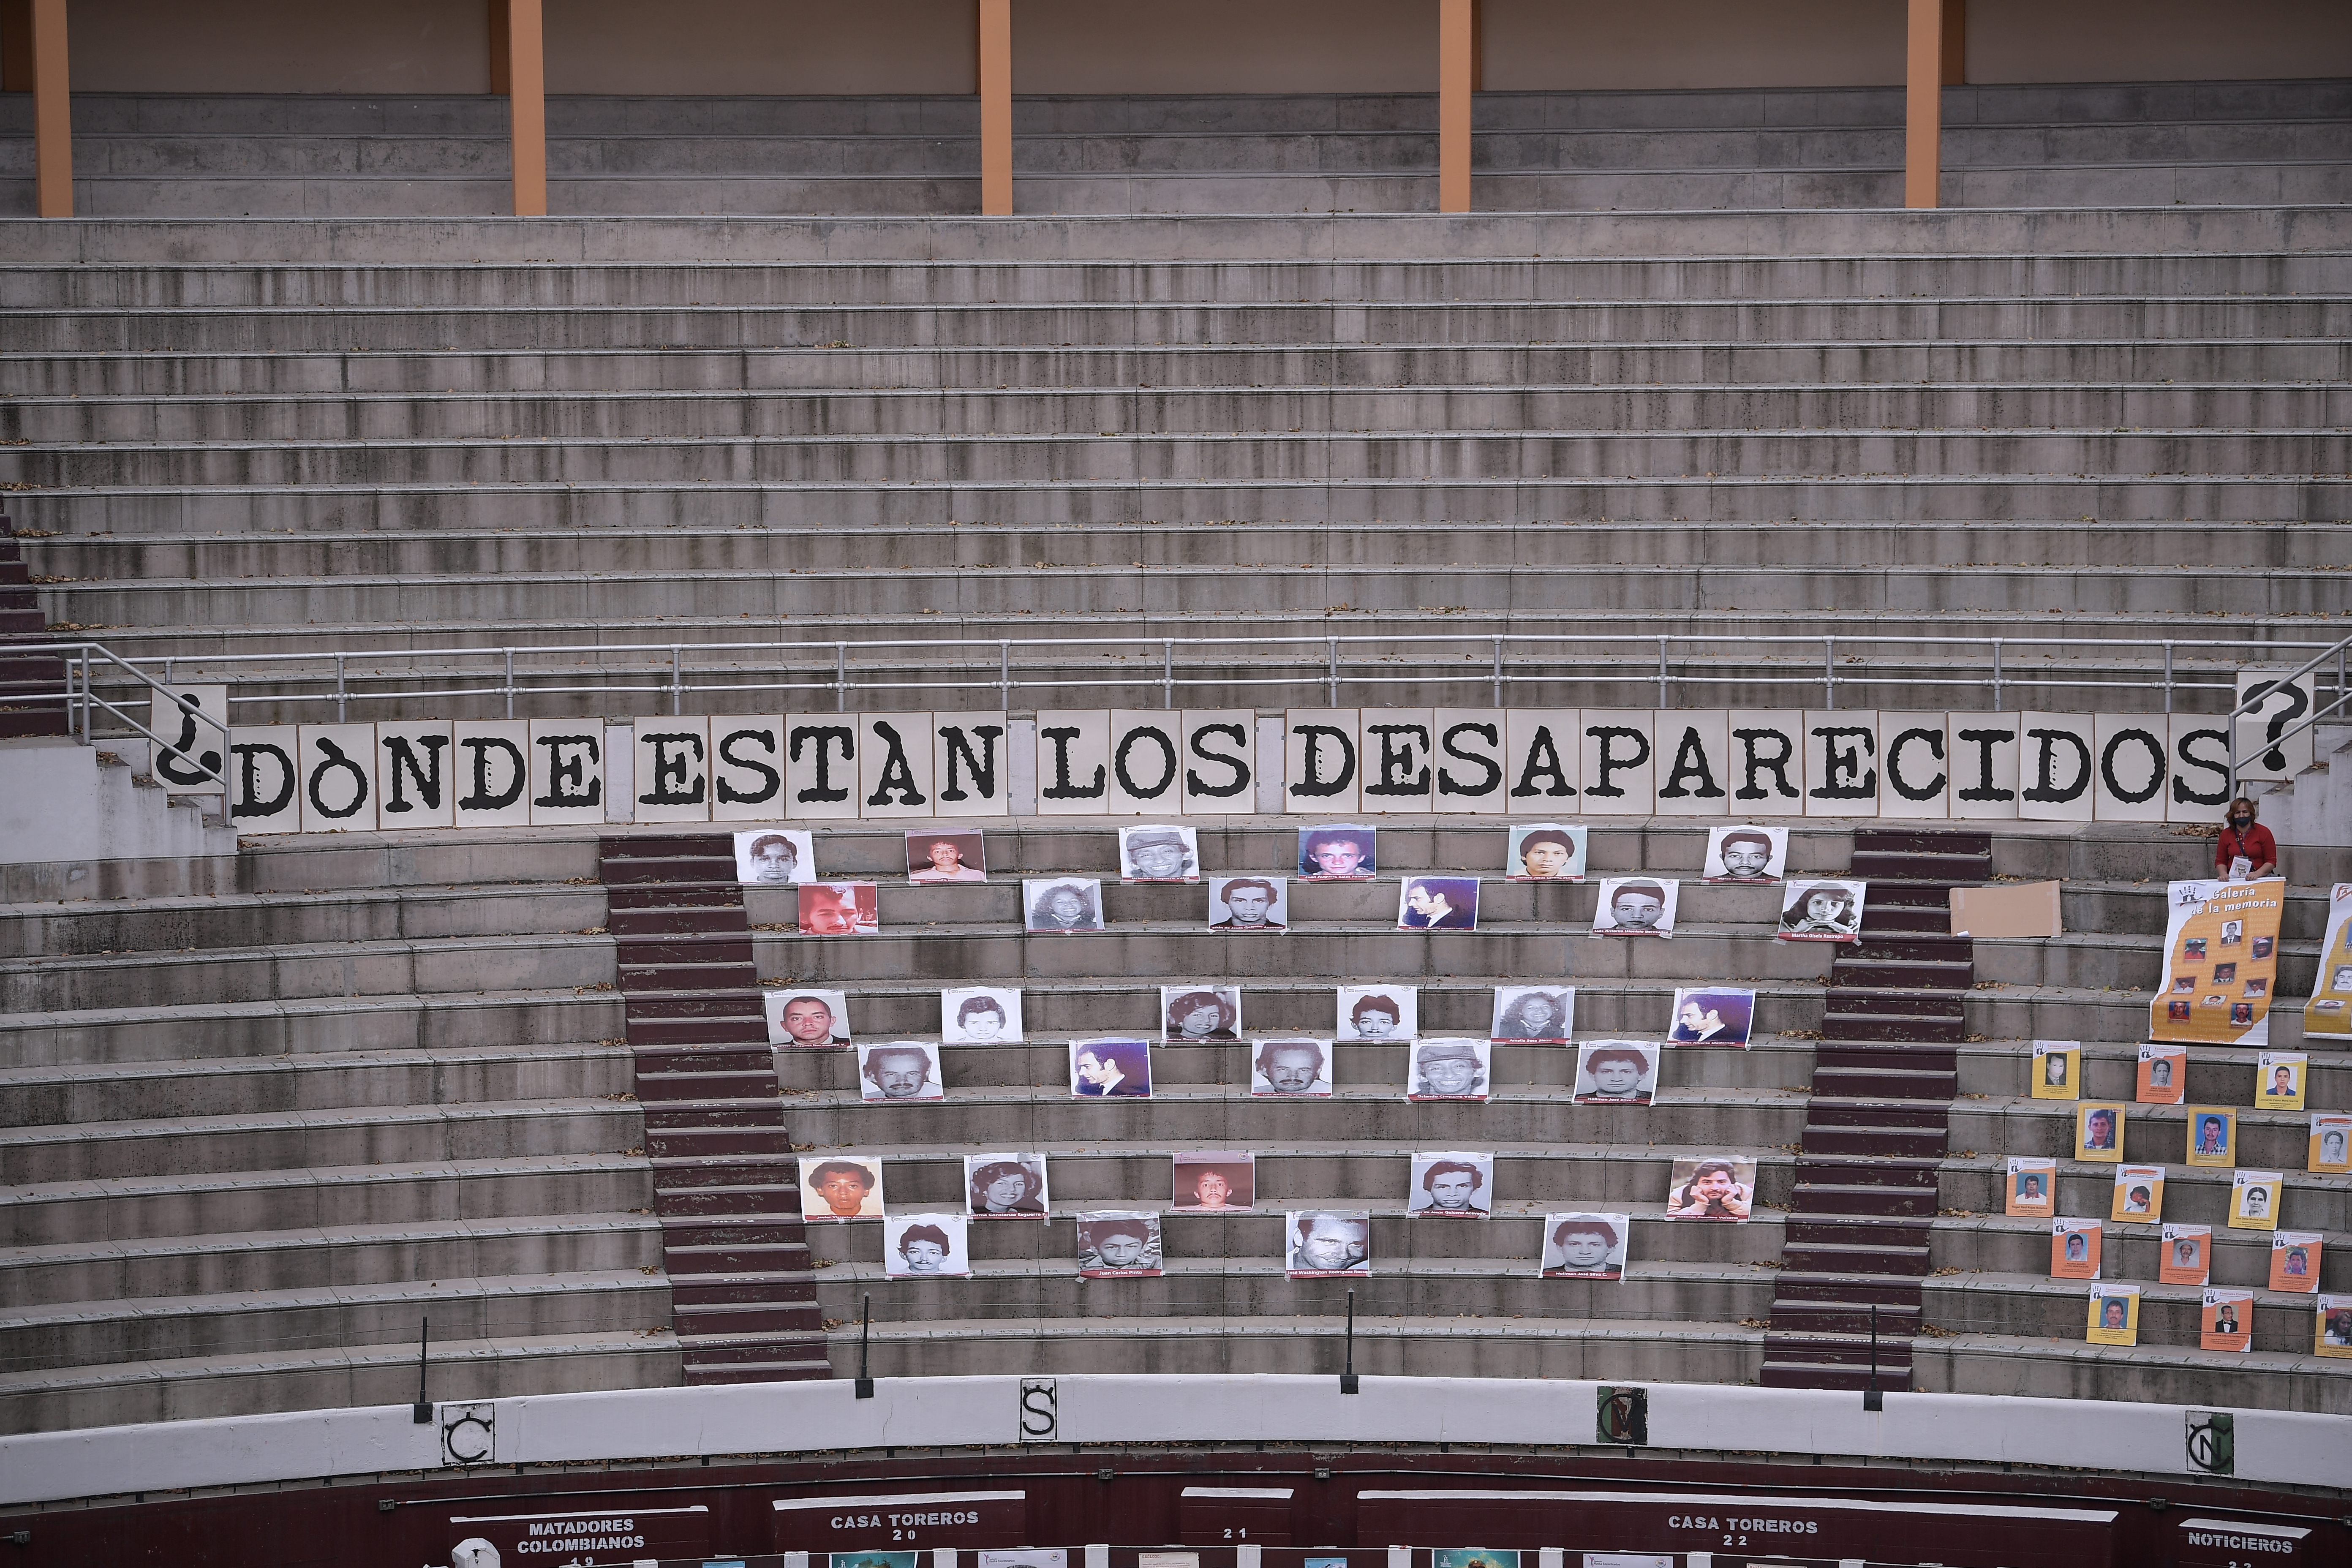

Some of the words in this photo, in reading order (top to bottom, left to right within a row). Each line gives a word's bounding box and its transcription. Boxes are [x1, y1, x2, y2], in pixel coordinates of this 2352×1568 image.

[1041, 723, 1251, 800] LOS
[2212, 887, 2256, 900] Galería
[2191, 906, 2203, 916] de
[2209, 903, 2220, 913] la
[2225, 898, 2277, 912] memoria
[529, 1519, 634, 1536] MATADORES
[831, 1515, 882, 1529] CASA
[888, 1511, 979, 1527] TOREROS
[1668, 1516, 1720, 1530] CASA
[1726, 1518, 1818, 1534] TOREROS
[517, 1535, 645, 1554] COLOMBIANOS
[2188, 1532, 2293, 1554] NOTICIEROS
